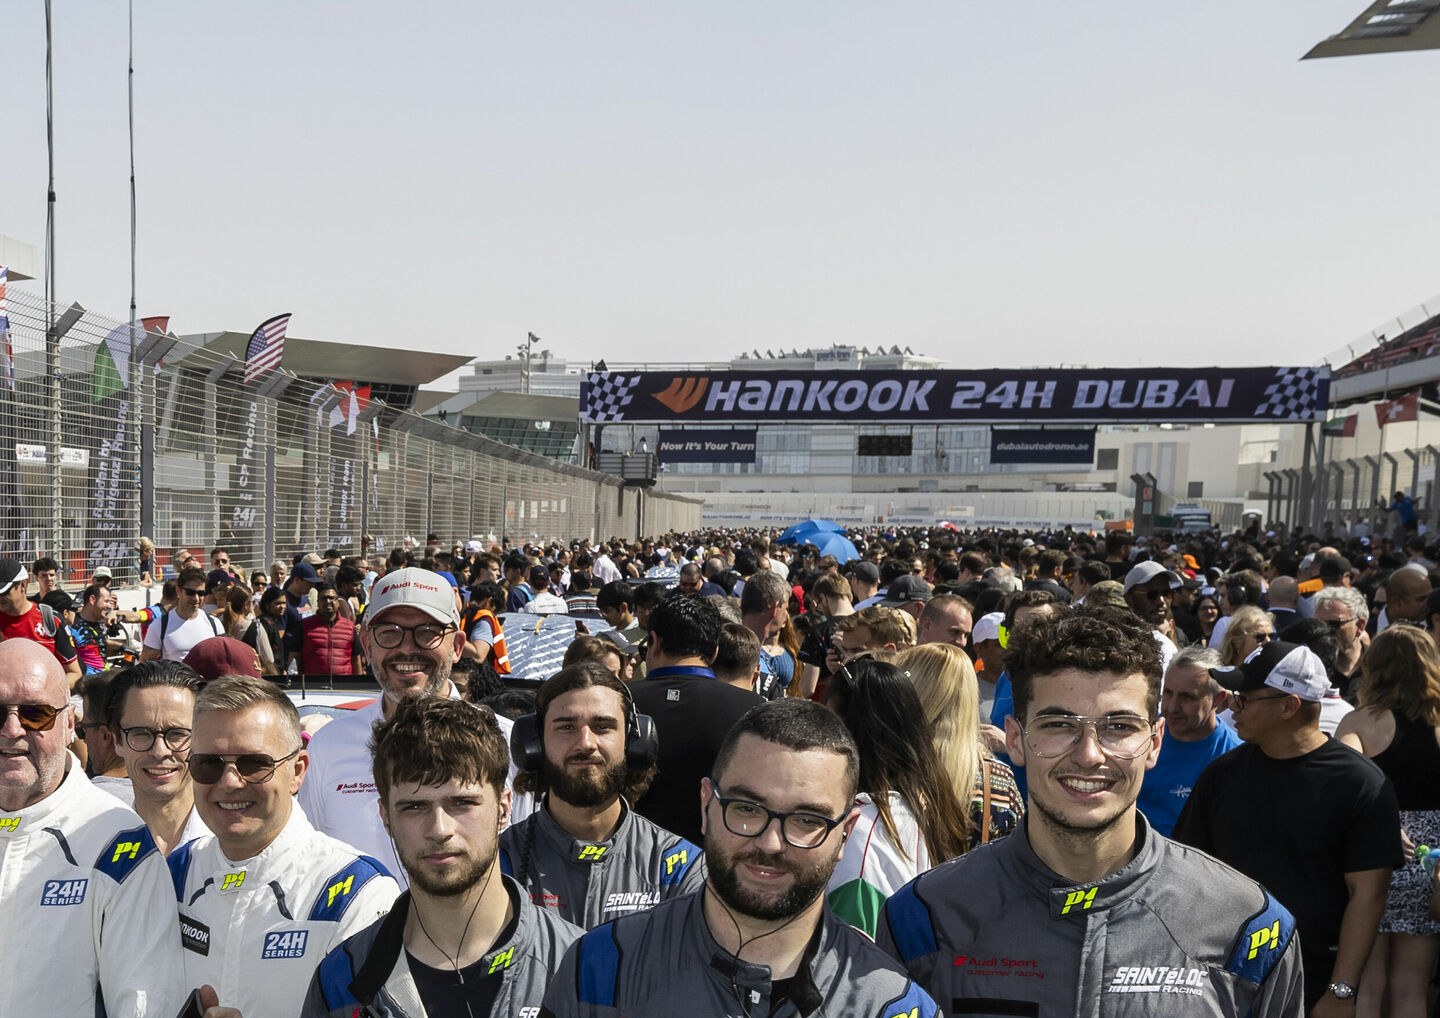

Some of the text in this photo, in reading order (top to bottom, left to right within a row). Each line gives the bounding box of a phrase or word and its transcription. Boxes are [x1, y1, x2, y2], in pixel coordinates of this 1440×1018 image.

[951, 380, 1057, 409] 24H
[1073, 378, 1235, 408] DUBAI
[660, 442, 755, 451] Now It's Your Turn
[390, 581, 439, 593] Audi Sport
[45, 879, 86, 897] 24H
[43, 896, 83, 906] SERIES
[265, 932, 308, 950] 24H
[263, 948, 305, 958] SERIES
[968, 957, 1038, 970] Audi Sport
[967, 968, 1045, 980] customer racing
[1162, 986, 1202, 996] RACING
